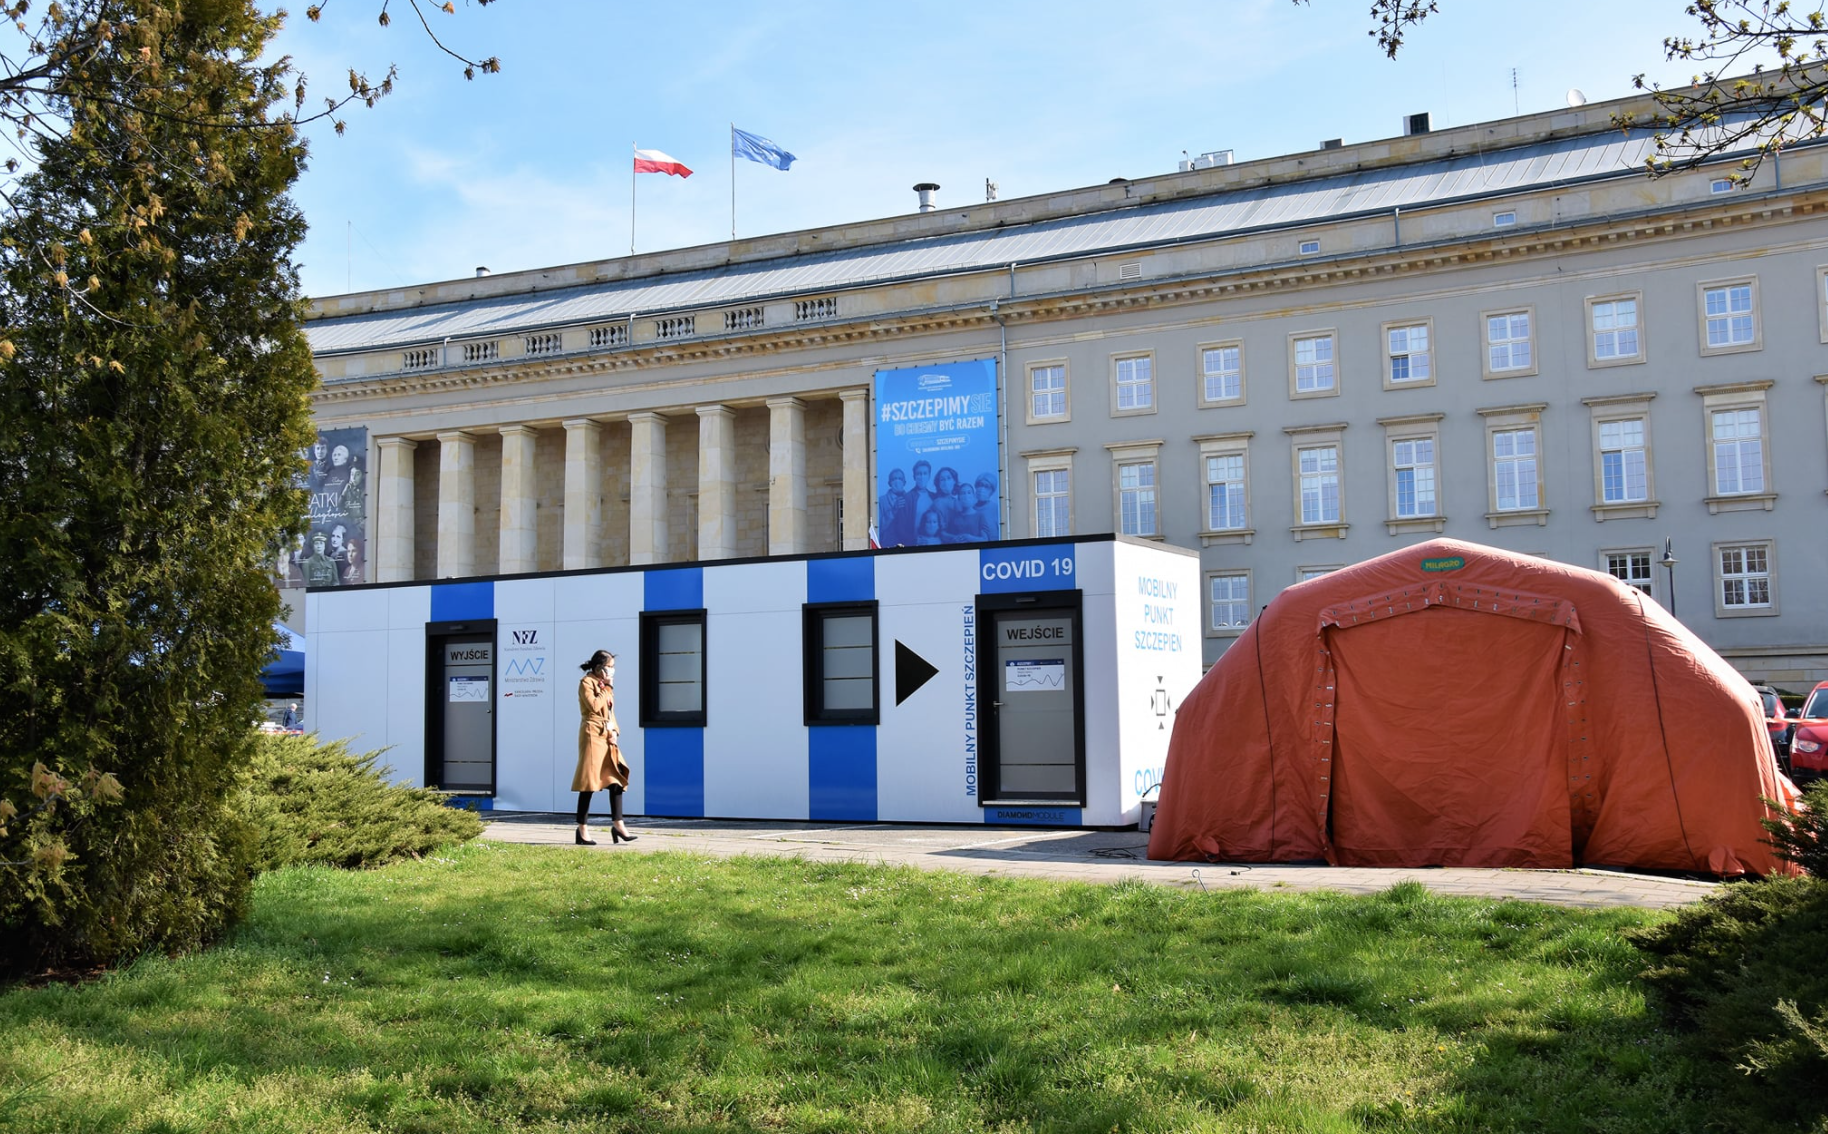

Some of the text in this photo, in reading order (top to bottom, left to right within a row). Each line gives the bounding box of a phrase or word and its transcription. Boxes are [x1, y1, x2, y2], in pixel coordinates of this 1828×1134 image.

[939, 417, 954, 431] BYĆ
[956, 415, 984, 430] RAZEM
[309, 492, 338, 508] ATKI
[982, 557, 1073, 581] COVID 19
[1138, 576, 1178, 600] MOBILNY
[1144, 604, 1174, 625] PUNKT
[512, 630, 538, 645] NFZ
[1006, 625, 1064, 640] WEJŚCIE
[450, 649, 489, 661] WYJŚCIE
[962, 605, 976, 796] MOBILNY PUNKT SZCZEPIEŃ
